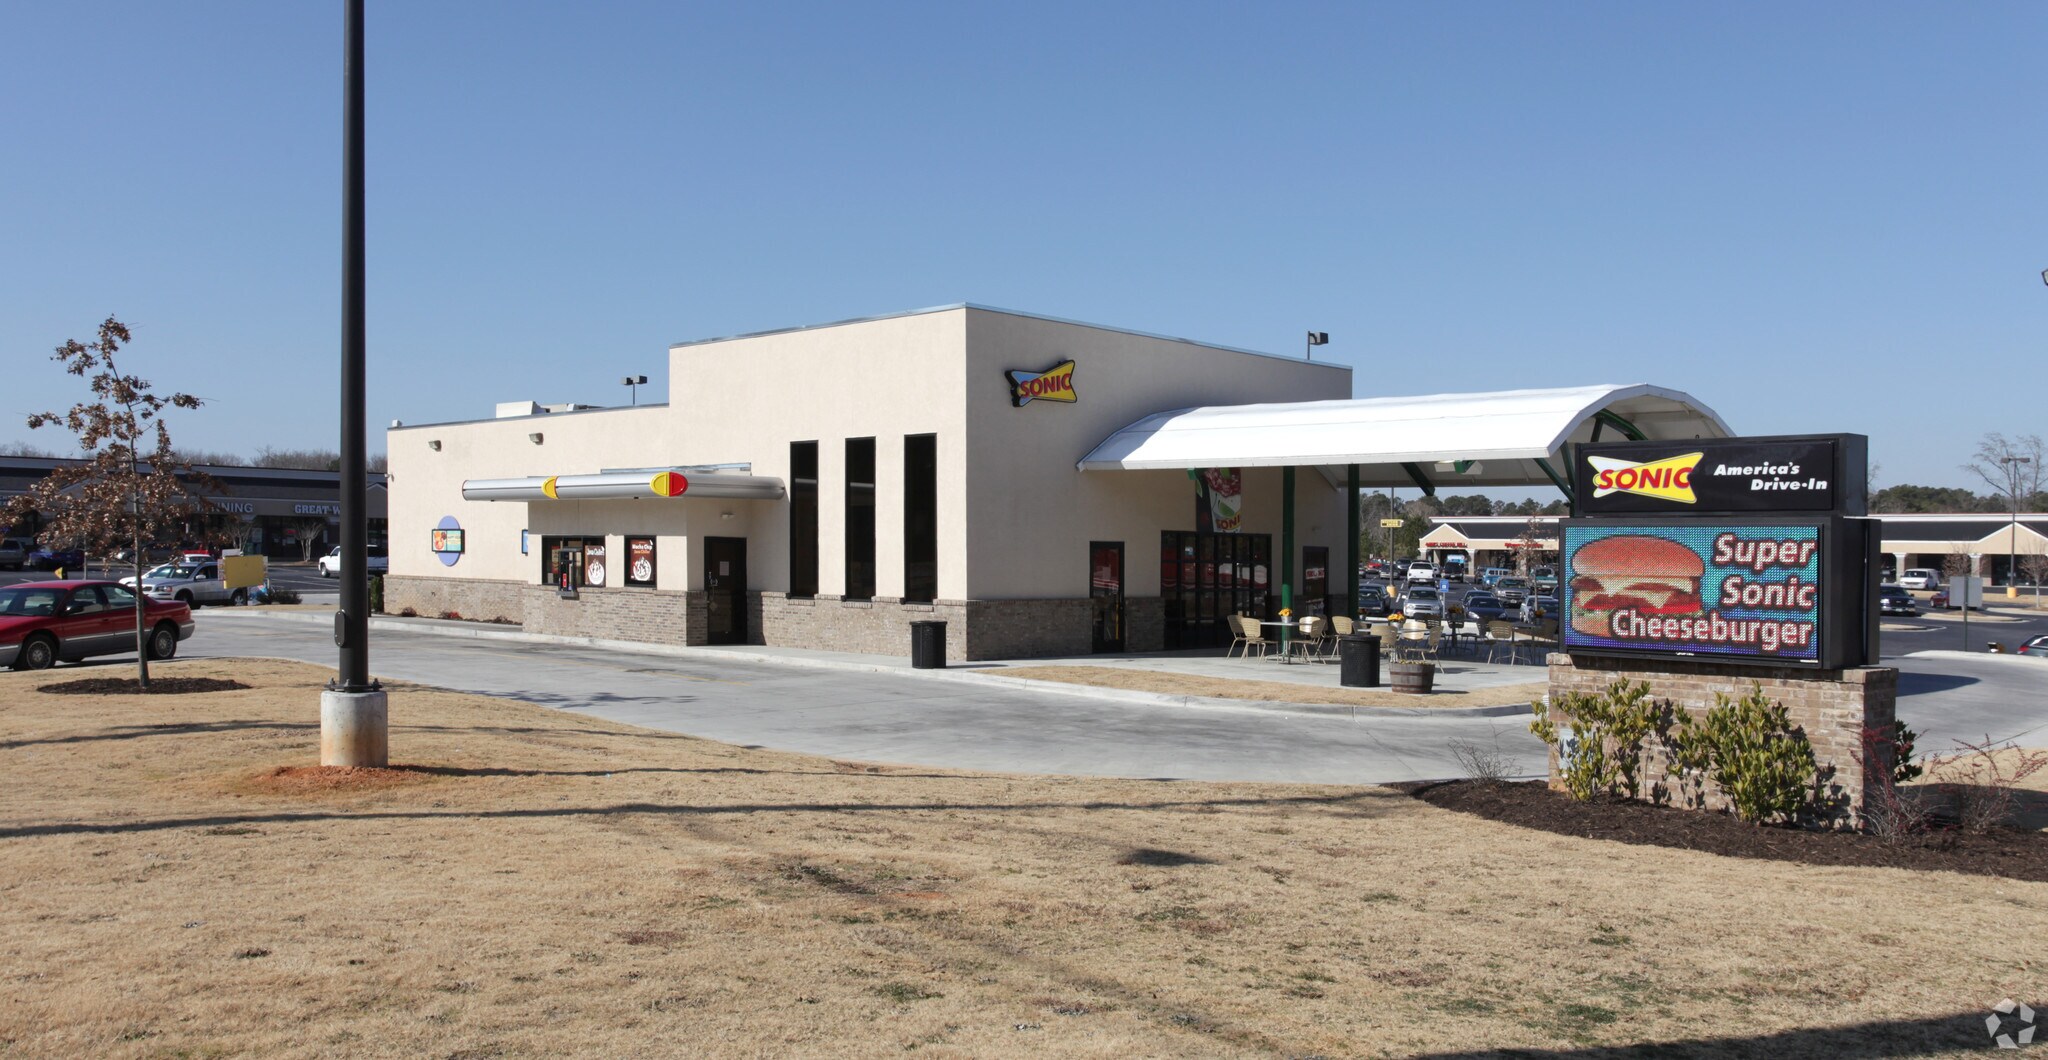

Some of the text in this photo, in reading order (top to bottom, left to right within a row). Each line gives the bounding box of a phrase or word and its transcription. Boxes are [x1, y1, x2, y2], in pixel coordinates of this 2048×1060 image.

[1020, 373, 1071, 398] SONIC
[1599, 467, 1693, 489] SONIC
[1713, 461, 1800, 476] America's
[195, 501, 254, 513] TNNING
[294, 504, 329, 514] GREAT
[1714, 534, 1816, 571] Super
[1722, 576, 1816, 608] Sonic
[1612, 609, 1813, 652] Cheeseburger
